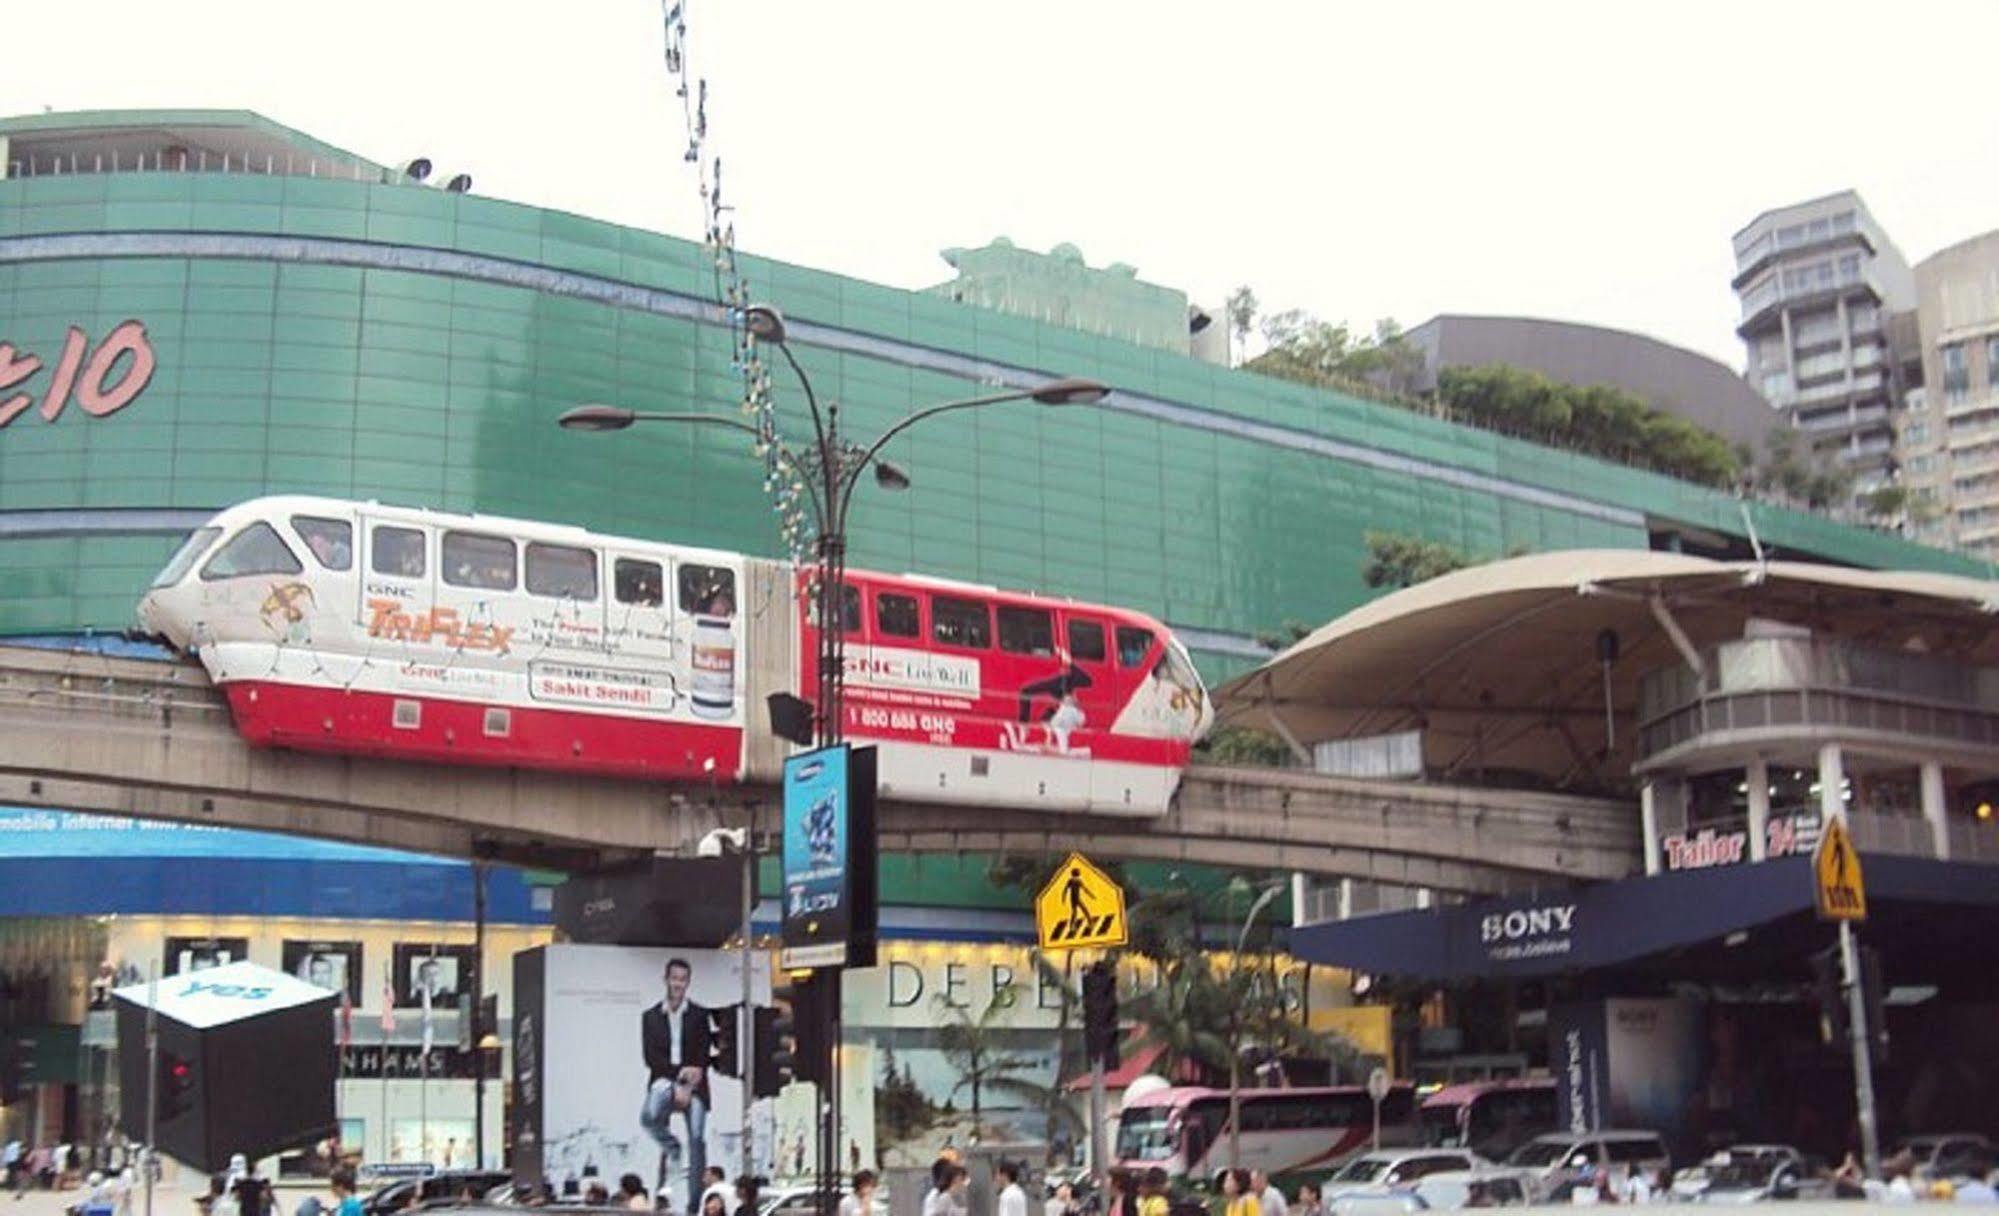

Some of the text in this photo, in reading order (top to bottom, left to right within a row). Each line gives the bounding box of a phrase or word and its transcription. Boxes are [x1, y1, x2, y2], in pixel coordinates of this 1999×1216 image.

[367, 583, 415, 597] GNC
[541, 677, 589, 698] Sakit
[1664, 829, 1745, 870] Tailor
[1481, 904, 1577, 942] SONY
[178, 981, 274, 1000] yes
